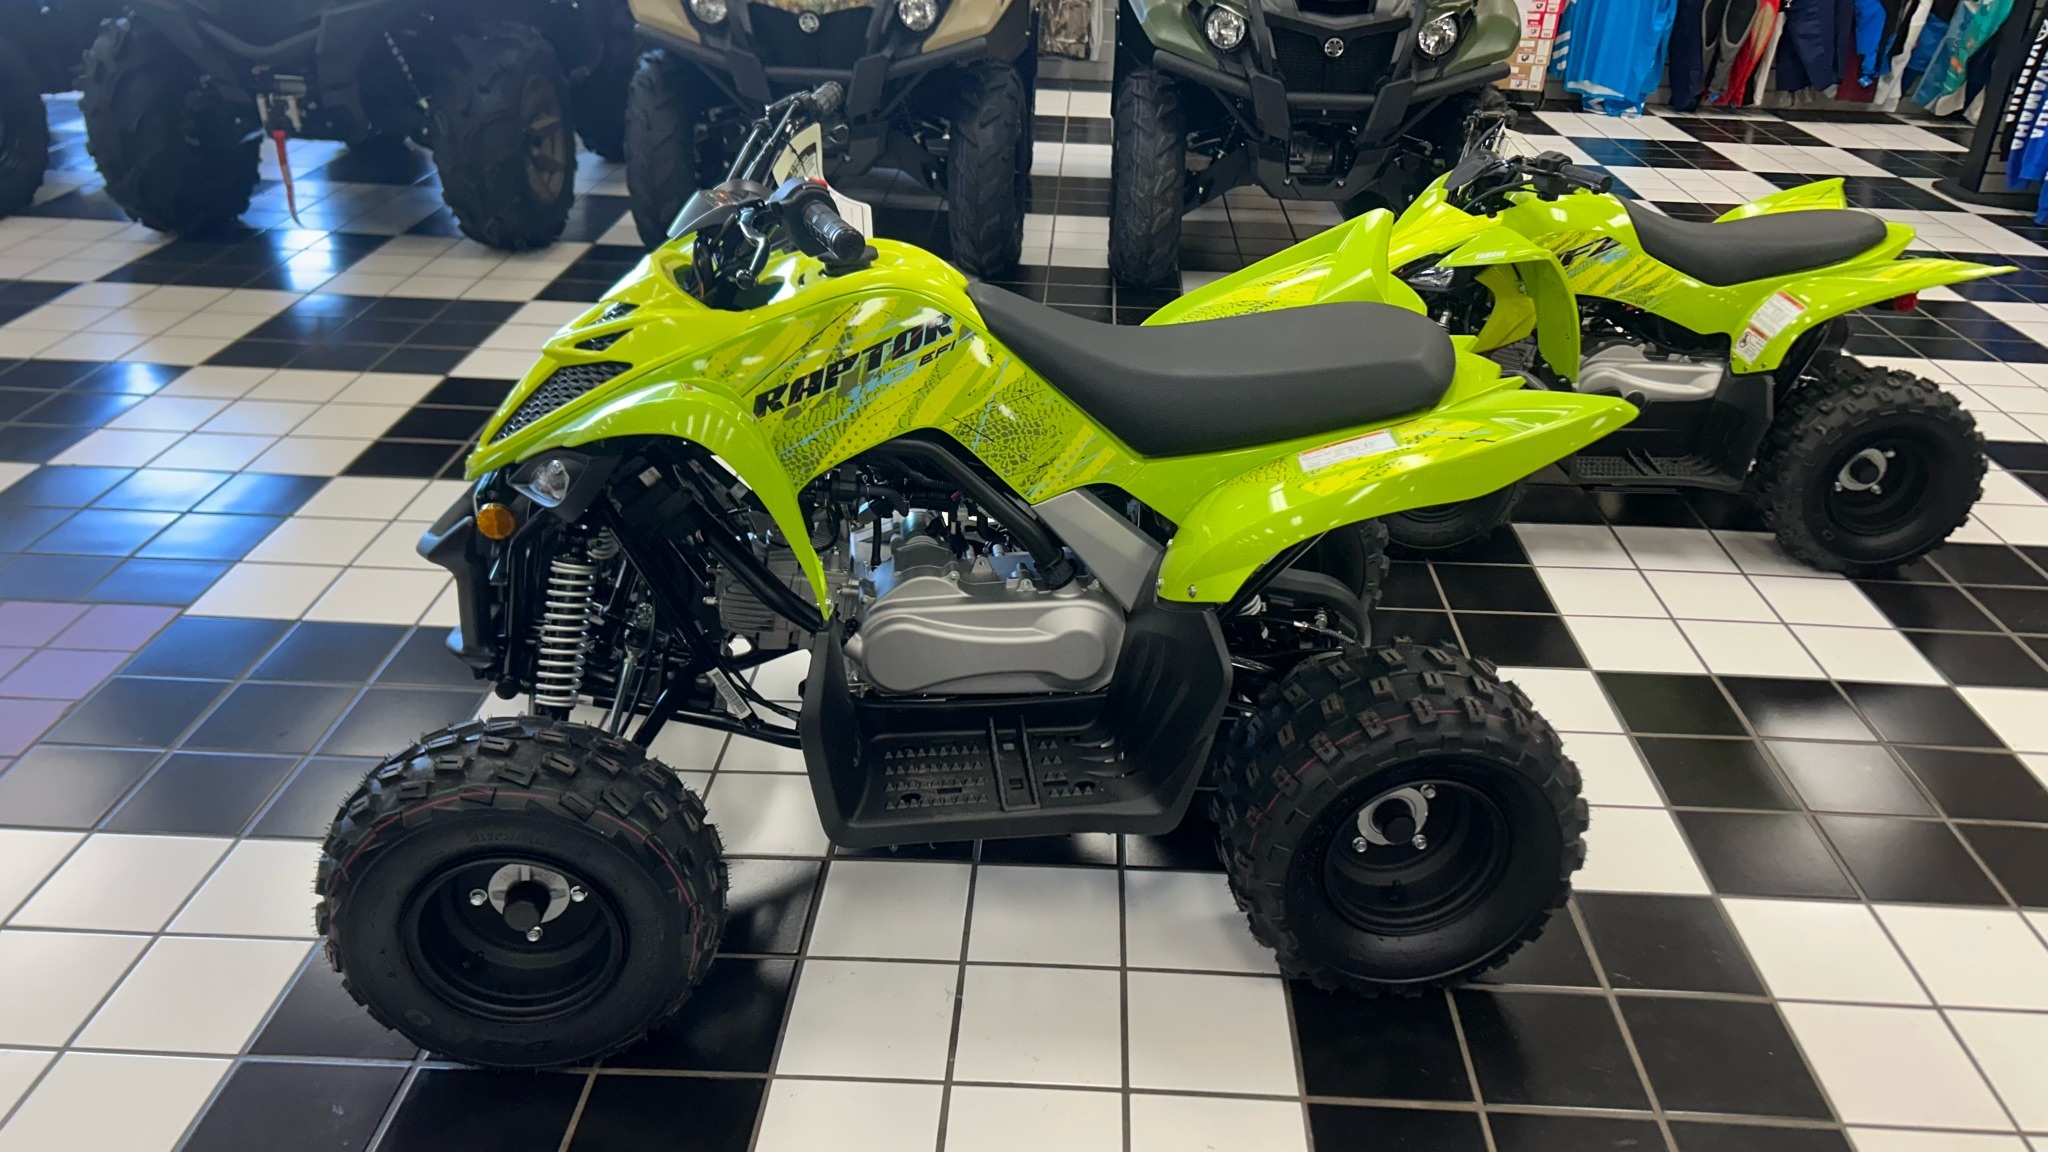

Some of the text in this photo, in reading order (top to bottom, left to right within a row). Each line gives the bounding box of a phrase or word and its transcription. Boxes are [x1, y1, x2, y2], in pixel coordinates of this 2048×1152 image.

[2010, 69, 2048, 151] YAMAHA
[752, 311, 954, 420] RAPTOR
[918, 339, 957, 368] EFI
